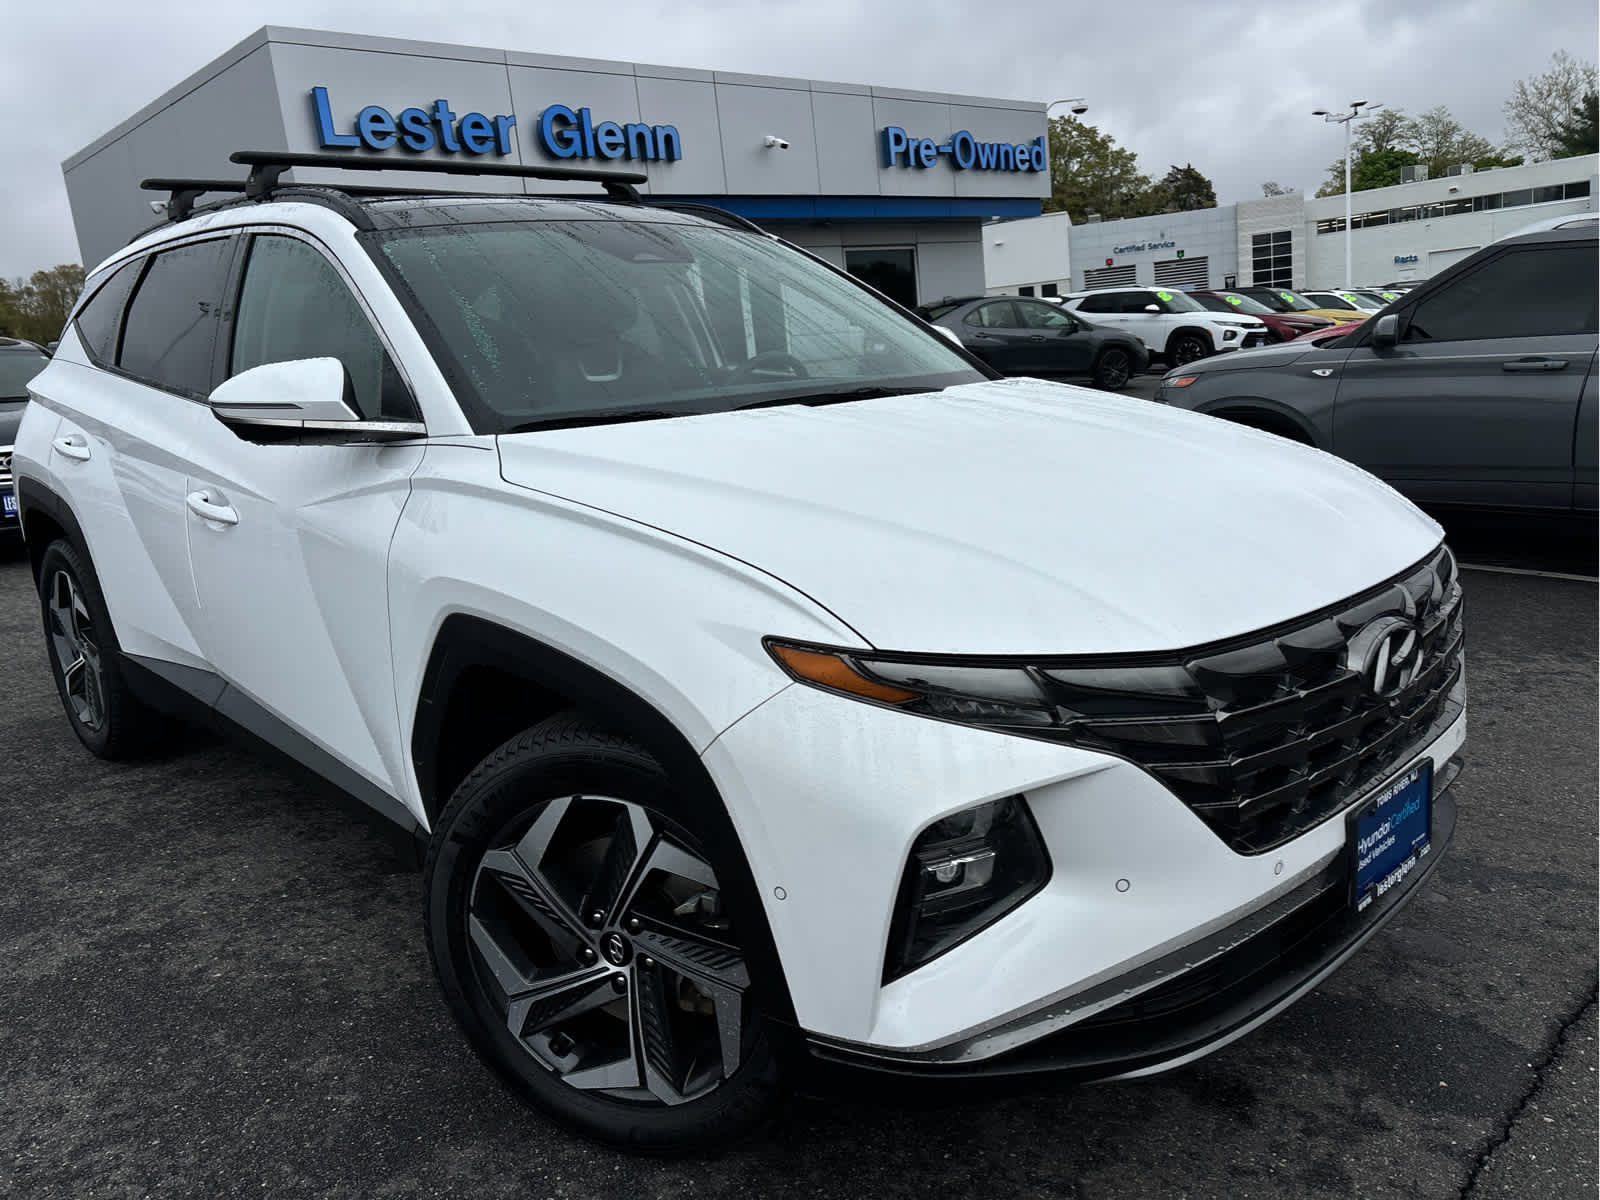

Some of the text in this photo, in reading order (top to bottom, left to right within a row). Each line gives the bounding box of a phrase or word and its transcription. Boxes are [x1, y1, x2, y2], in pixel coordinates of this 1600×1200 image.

[308, 86, 682, 161] Lester Glenn
[883, 126, 1047, 172] Pre-Owned
[1113, 240, 1176, 255] Certified Service
[1394, 254, 1418, 264] Parts
[1376, 789, 1393, 808] TOMS
[1371, 834, 1396, 859] Vehicles
